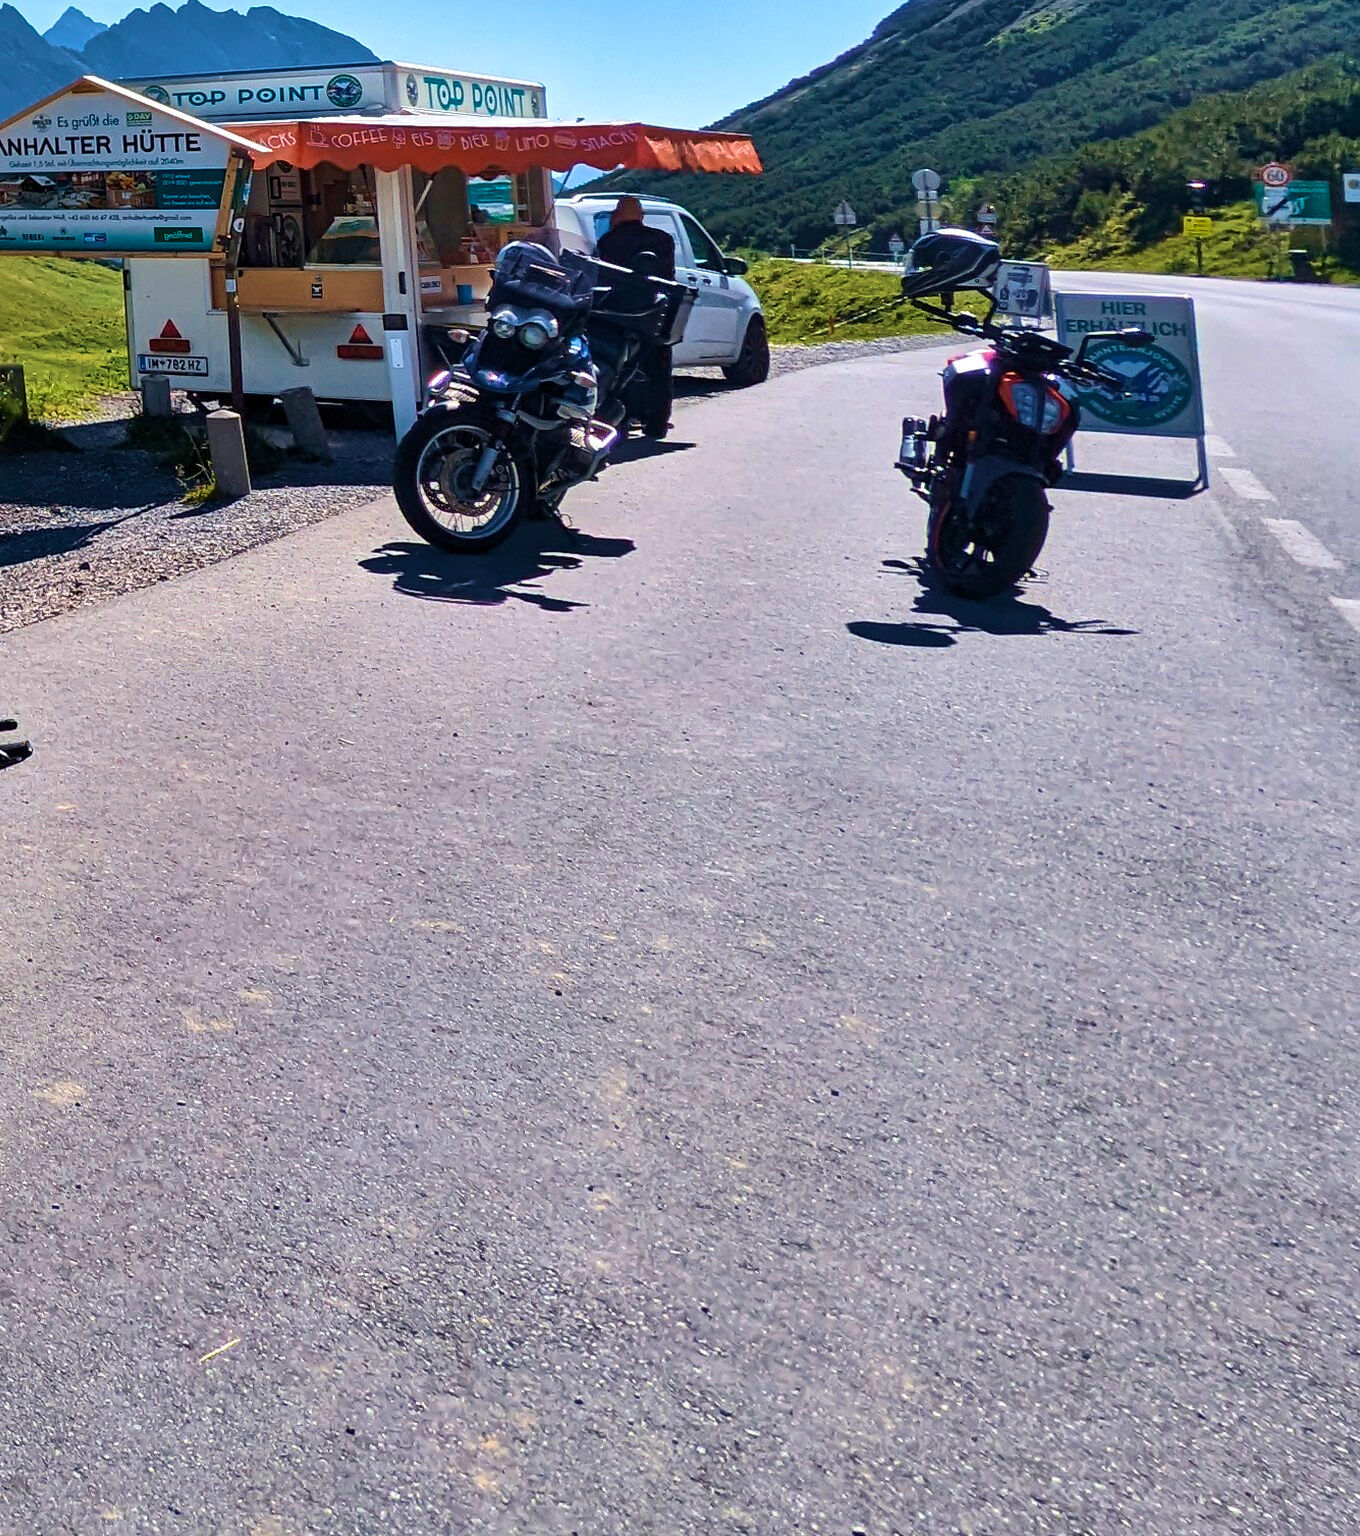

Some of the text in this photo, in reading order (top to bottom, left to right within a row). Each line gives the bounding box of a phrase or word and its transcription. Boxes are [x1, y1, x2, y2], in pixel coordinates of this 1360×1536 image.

[172, 84, 325, 107] TOP POINT
[423, 76, 525, 118] TOP POINT
[57, 116, 69, 128] Es
[71, 114, 100, 131] grüßt
[102, 113, 120, 126] die
[122, 129, 202, 154] HÜTTE
[331, 128, 388, 148] COFFEE
[411, 132, 434, 147] EIS
[460, 133, 491, 150] BIER
[515, 134, 550, 152] LIMO
[1101, 301, 1147, 315] HIER
